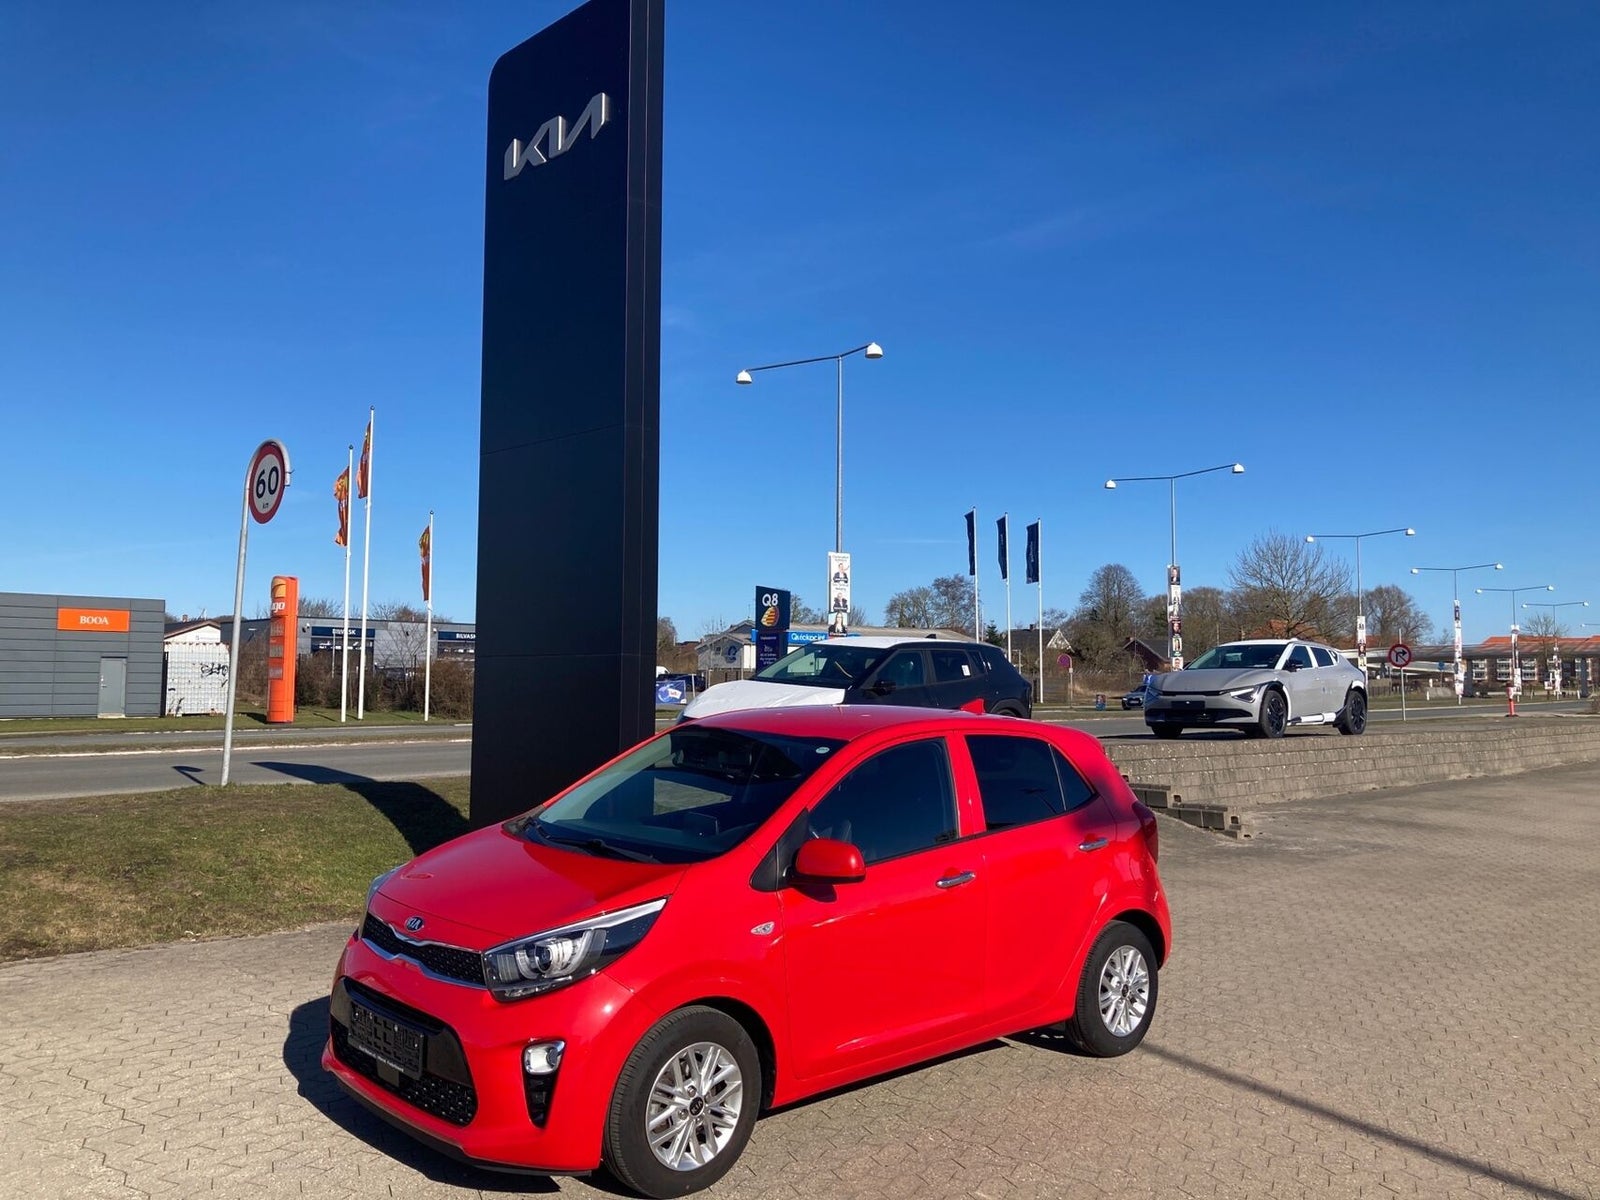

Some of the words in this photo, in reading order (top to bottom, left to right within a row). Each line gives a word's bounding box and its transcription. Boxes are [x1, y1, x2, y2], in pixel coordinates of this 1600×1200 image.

[503, 92, 610, 180] KIA
[256, 466, 279, 499] 60
[762, 593, 778, 607] Q8
[79, 615, 109, 625] BOOA
[407, 917, 421, 930] KIA
